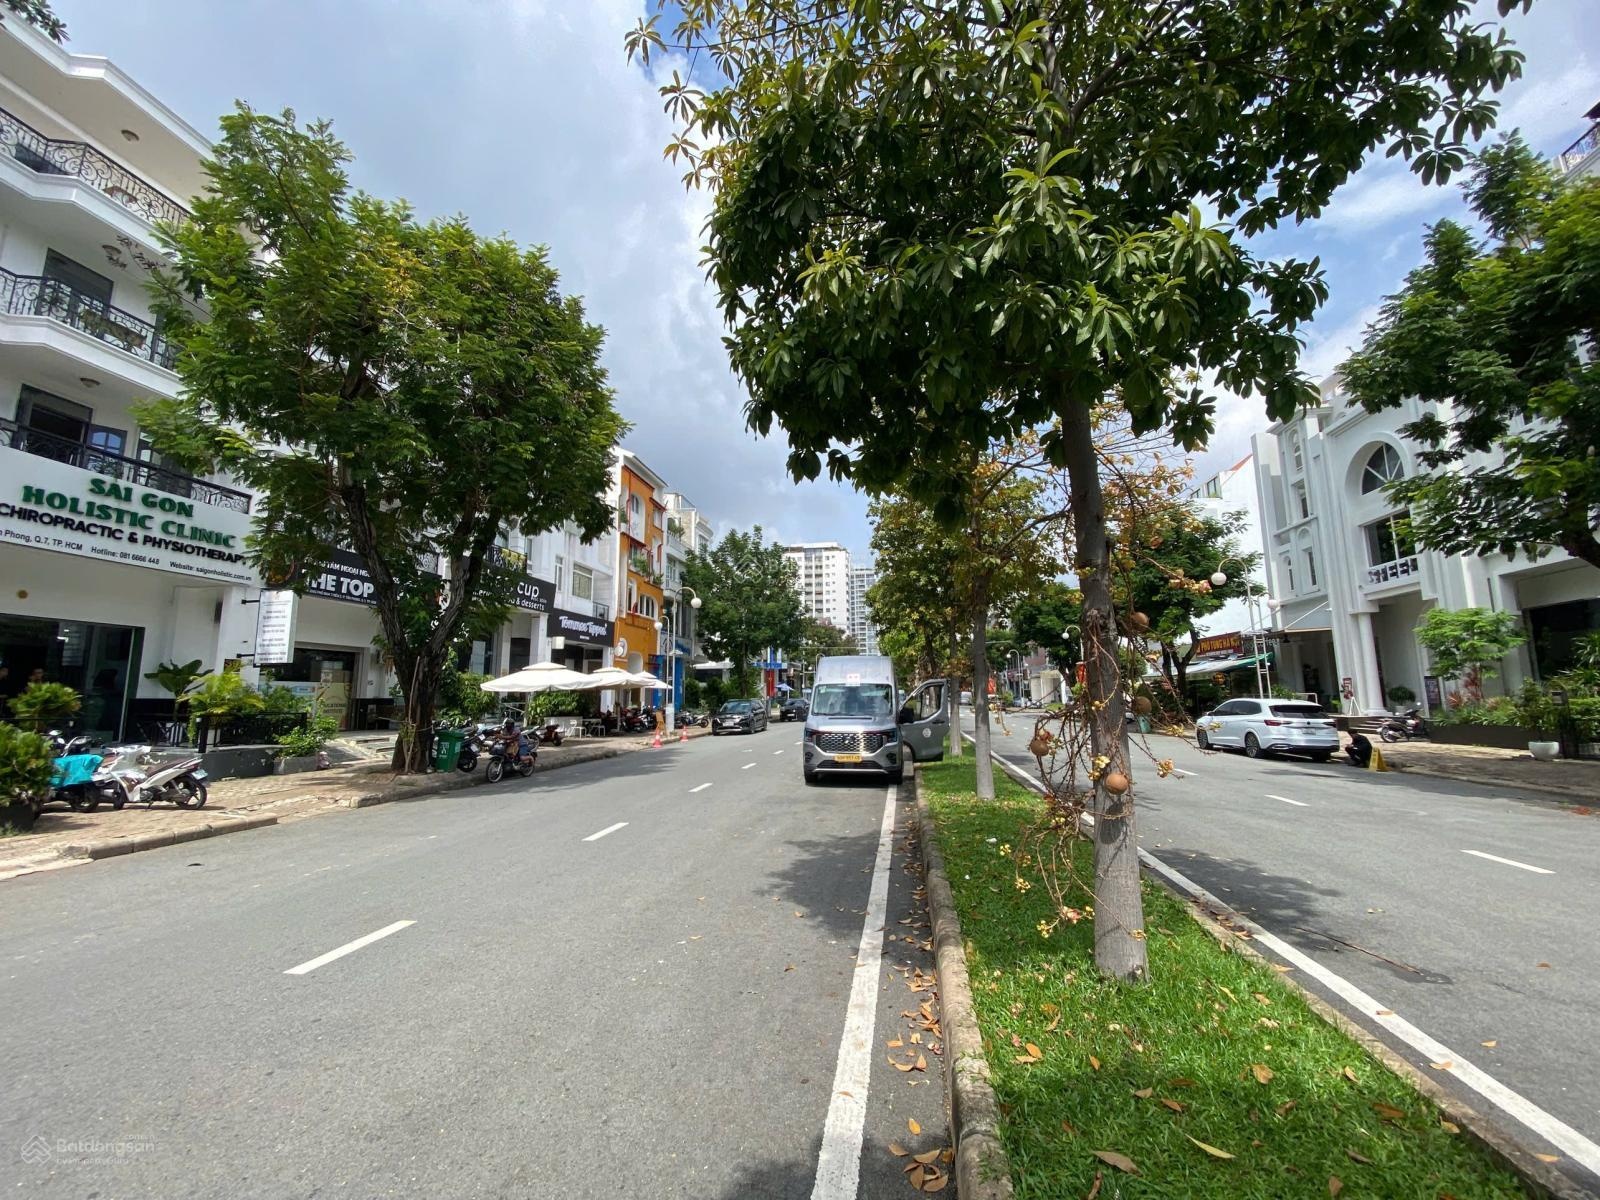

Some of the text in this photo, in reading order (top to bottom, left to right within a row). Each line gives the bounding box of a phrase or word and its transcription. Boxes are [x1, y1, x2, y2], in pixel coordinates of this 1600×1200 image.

[88, 478, 195, 518] SAI GON
[0, 502, 124, 541] CHIROPRACTIC
[128, 531, 139, 544] &
[22, 485, 237, 549] HOLISTIC CLINIC
[4, 529, 32, 543] Phong,
[65, 541, 83, 552] HCM
[91, 546, 118, 558] Hotline:
[340, 576, 375, 598] TOP
[517, 582, 540, 599] cup
[521, 599, 545, 611] desserts
